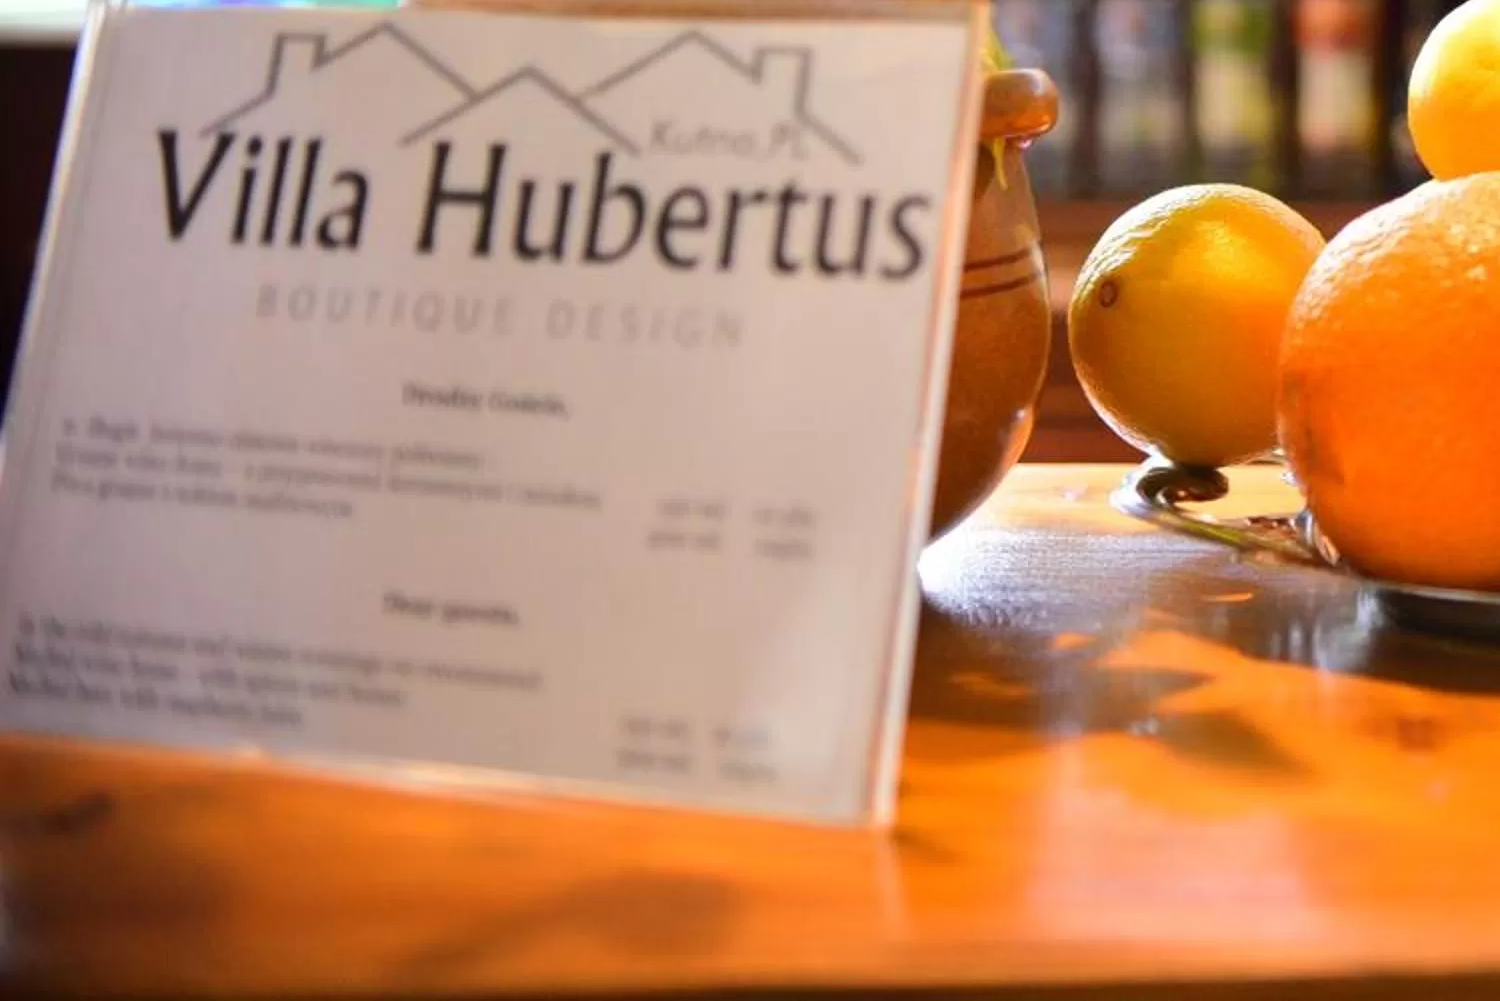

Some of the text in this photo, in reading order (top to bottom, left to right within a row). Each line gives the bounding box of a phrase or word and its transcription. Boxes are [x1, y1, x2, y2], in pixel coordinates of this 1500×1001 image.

[157, 130, 936, 282] Villa Hubertus
[254, 285, 747, 348] BOUTIQUE DESIGN
